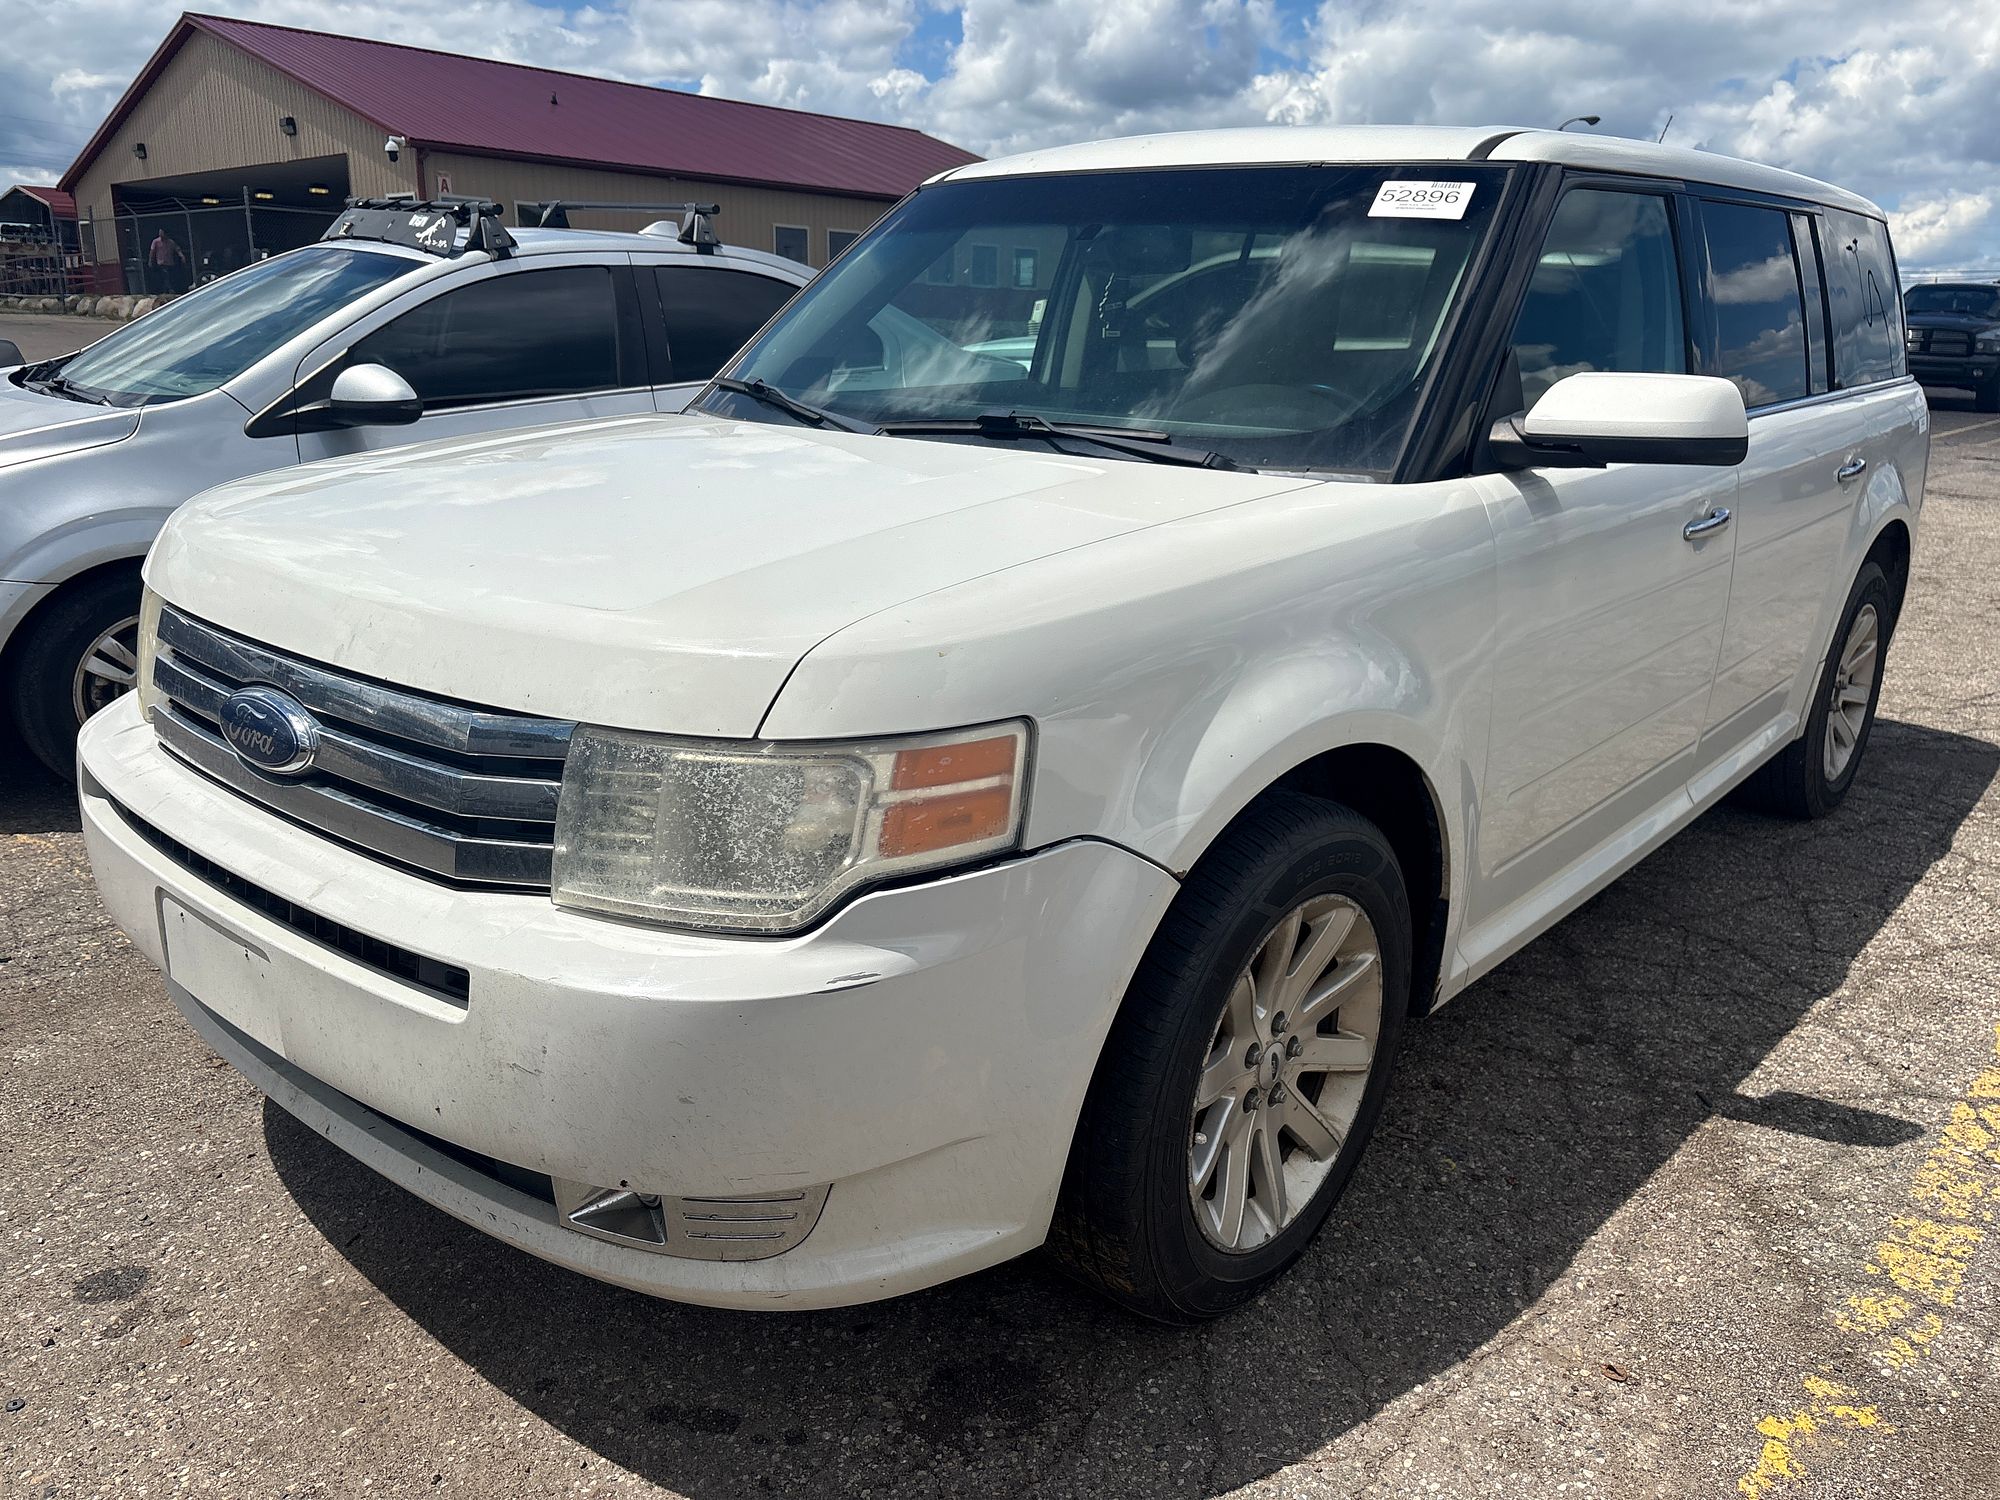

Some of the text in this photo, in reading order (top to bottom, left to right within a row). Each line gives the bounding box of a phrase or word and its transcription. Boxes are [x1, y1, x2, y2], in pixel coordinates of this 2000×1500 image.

[440, 178, 450, 193] A
[1380, 190, 1460, 203] 52896
[229, 702, 278, 756] Ford
